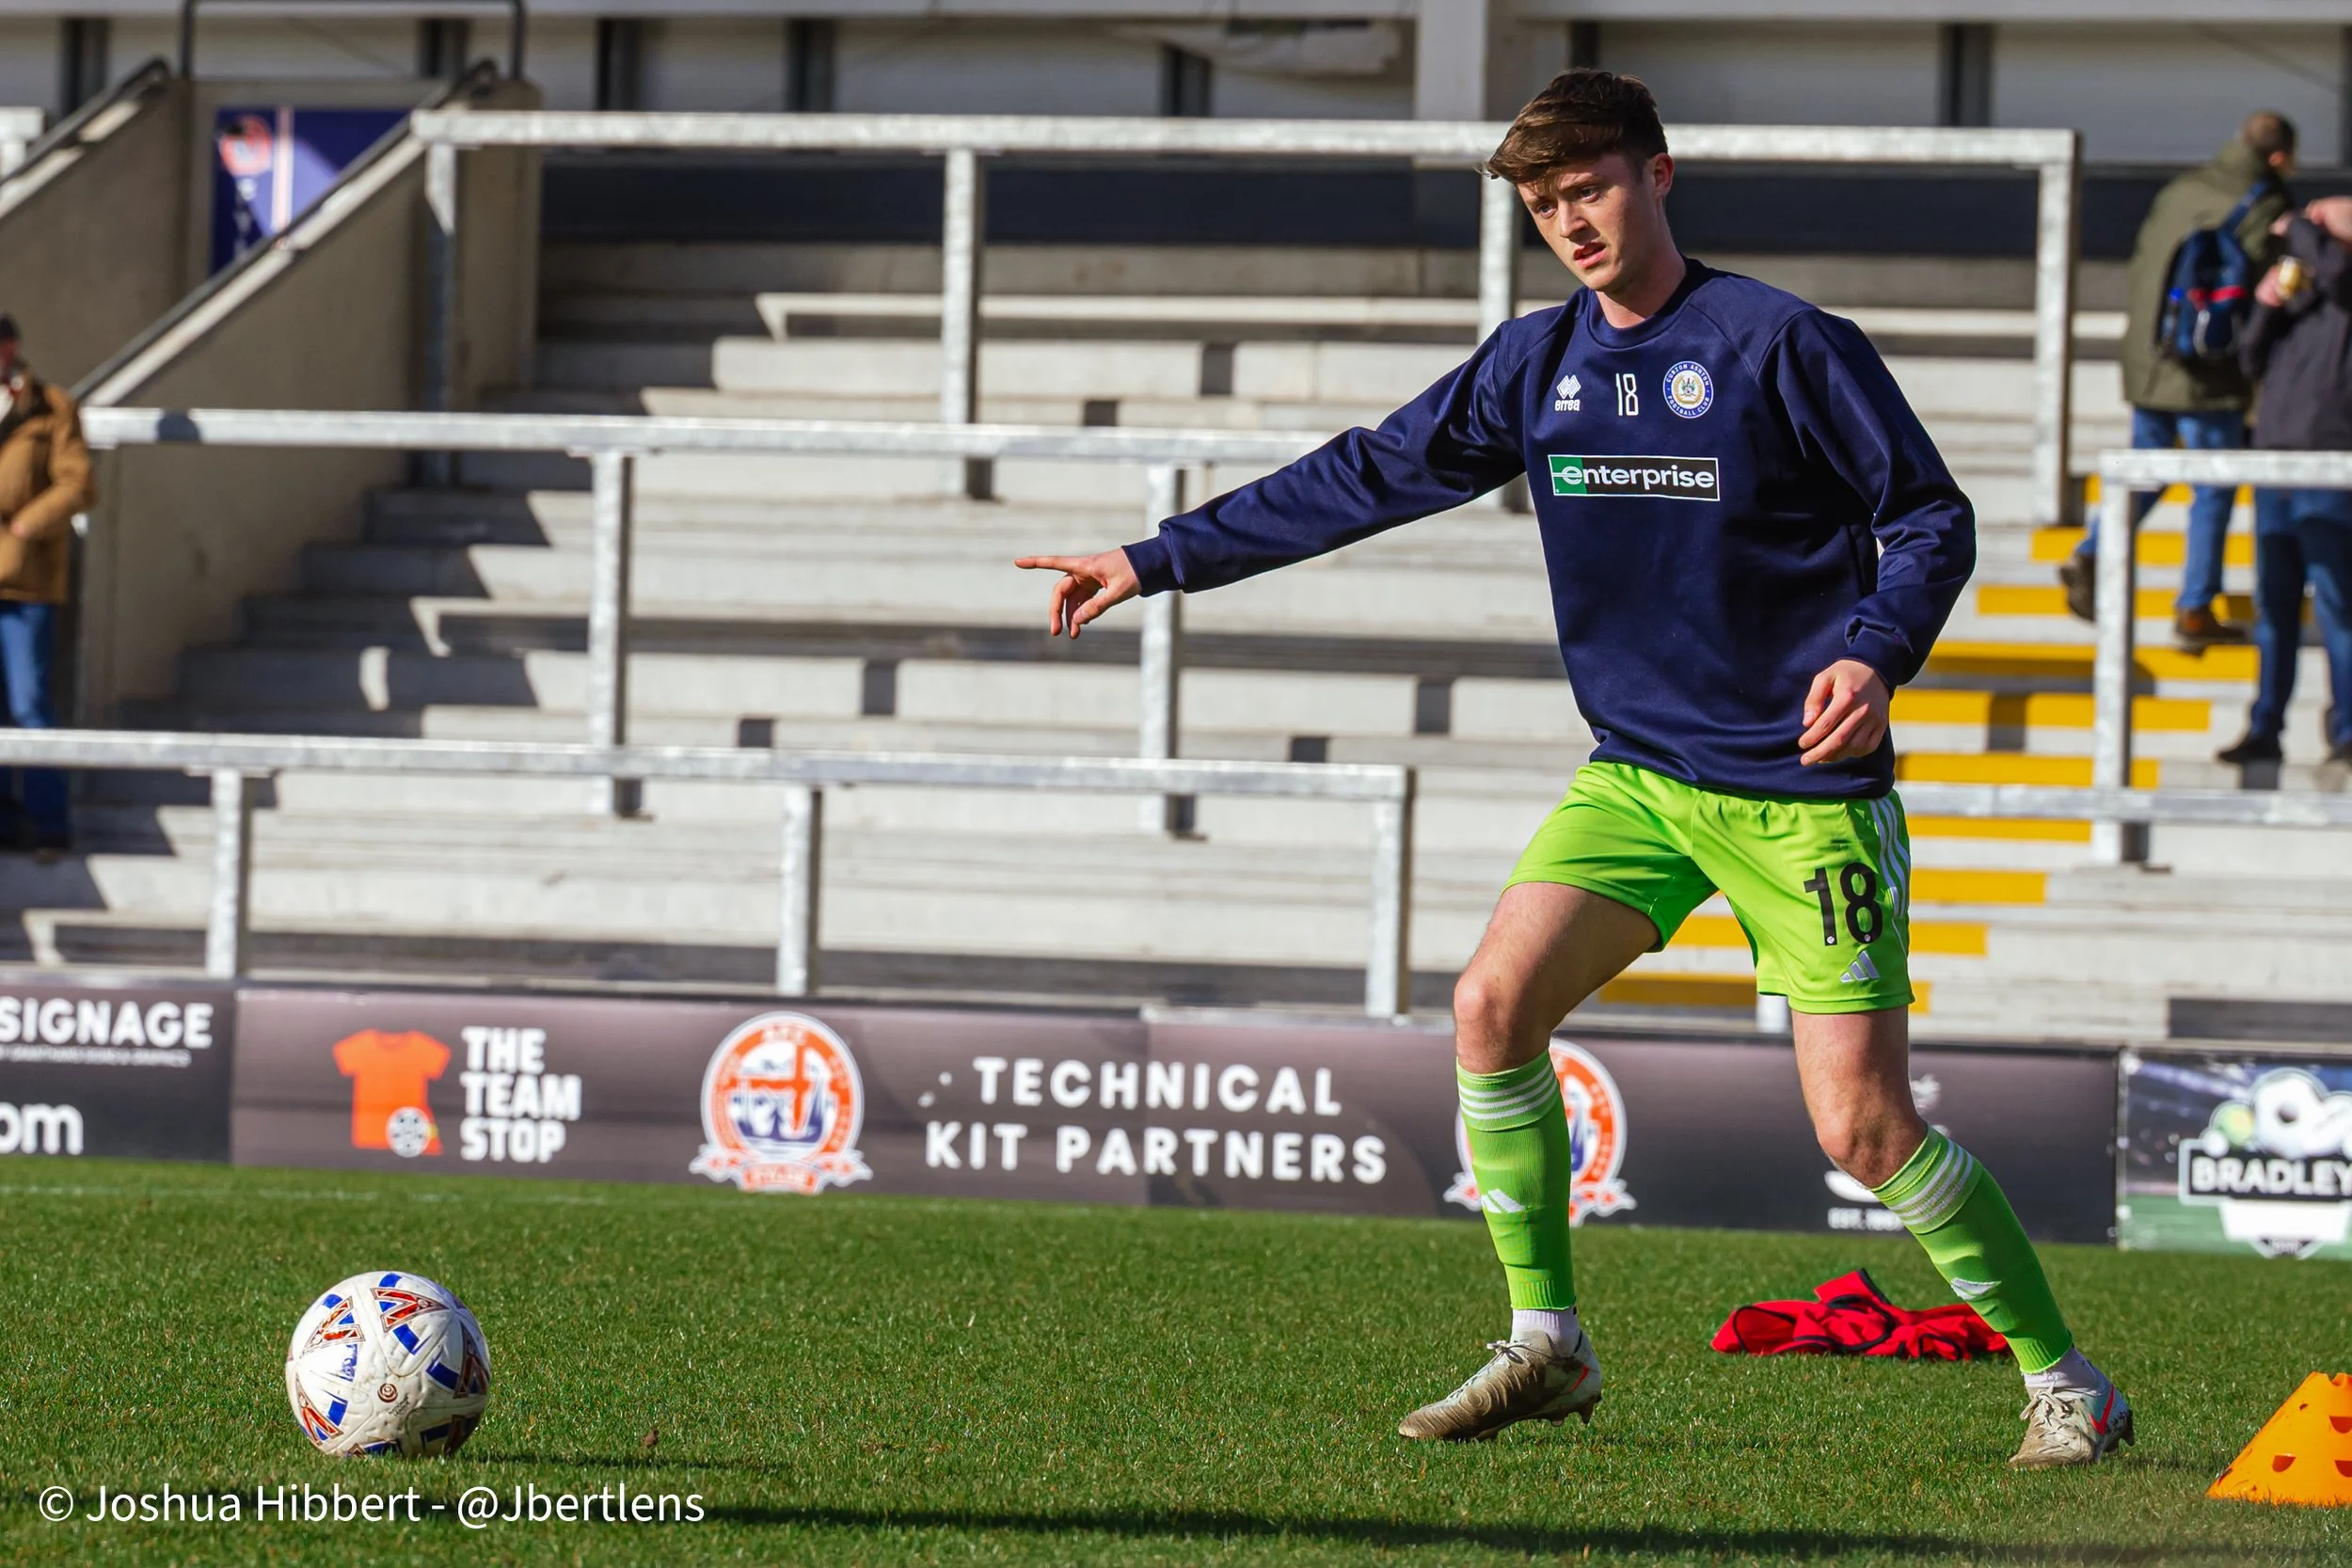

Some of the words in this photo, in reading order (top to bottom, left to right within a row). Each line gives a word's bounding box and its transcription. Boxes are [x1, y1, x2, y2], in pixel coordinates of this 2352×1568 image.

[1615, 372, 1639, 416] 18
[1690, 364, 1709, 386] ASHTON
[1667, 395, 1696, 416] FOOTBALL
[1697, 397, 1709, 413] CLUB
[1553, 465, 1715, 490] enterprise
[1804, 862, 1883, 946] 18
[0, 996, 214, 1049] SIGNAGE
[461, 1025, 547, 1074] THE
[459, 1070, 582, 1121] TEAM
[973, 1056, 1342, 1117] TECHNICAL
[459, 1117, 566, 1164] STOP
[926, 1120, 1027, 1170] KIT
[1056, 1125, 1388, 1184] PARTNERS
